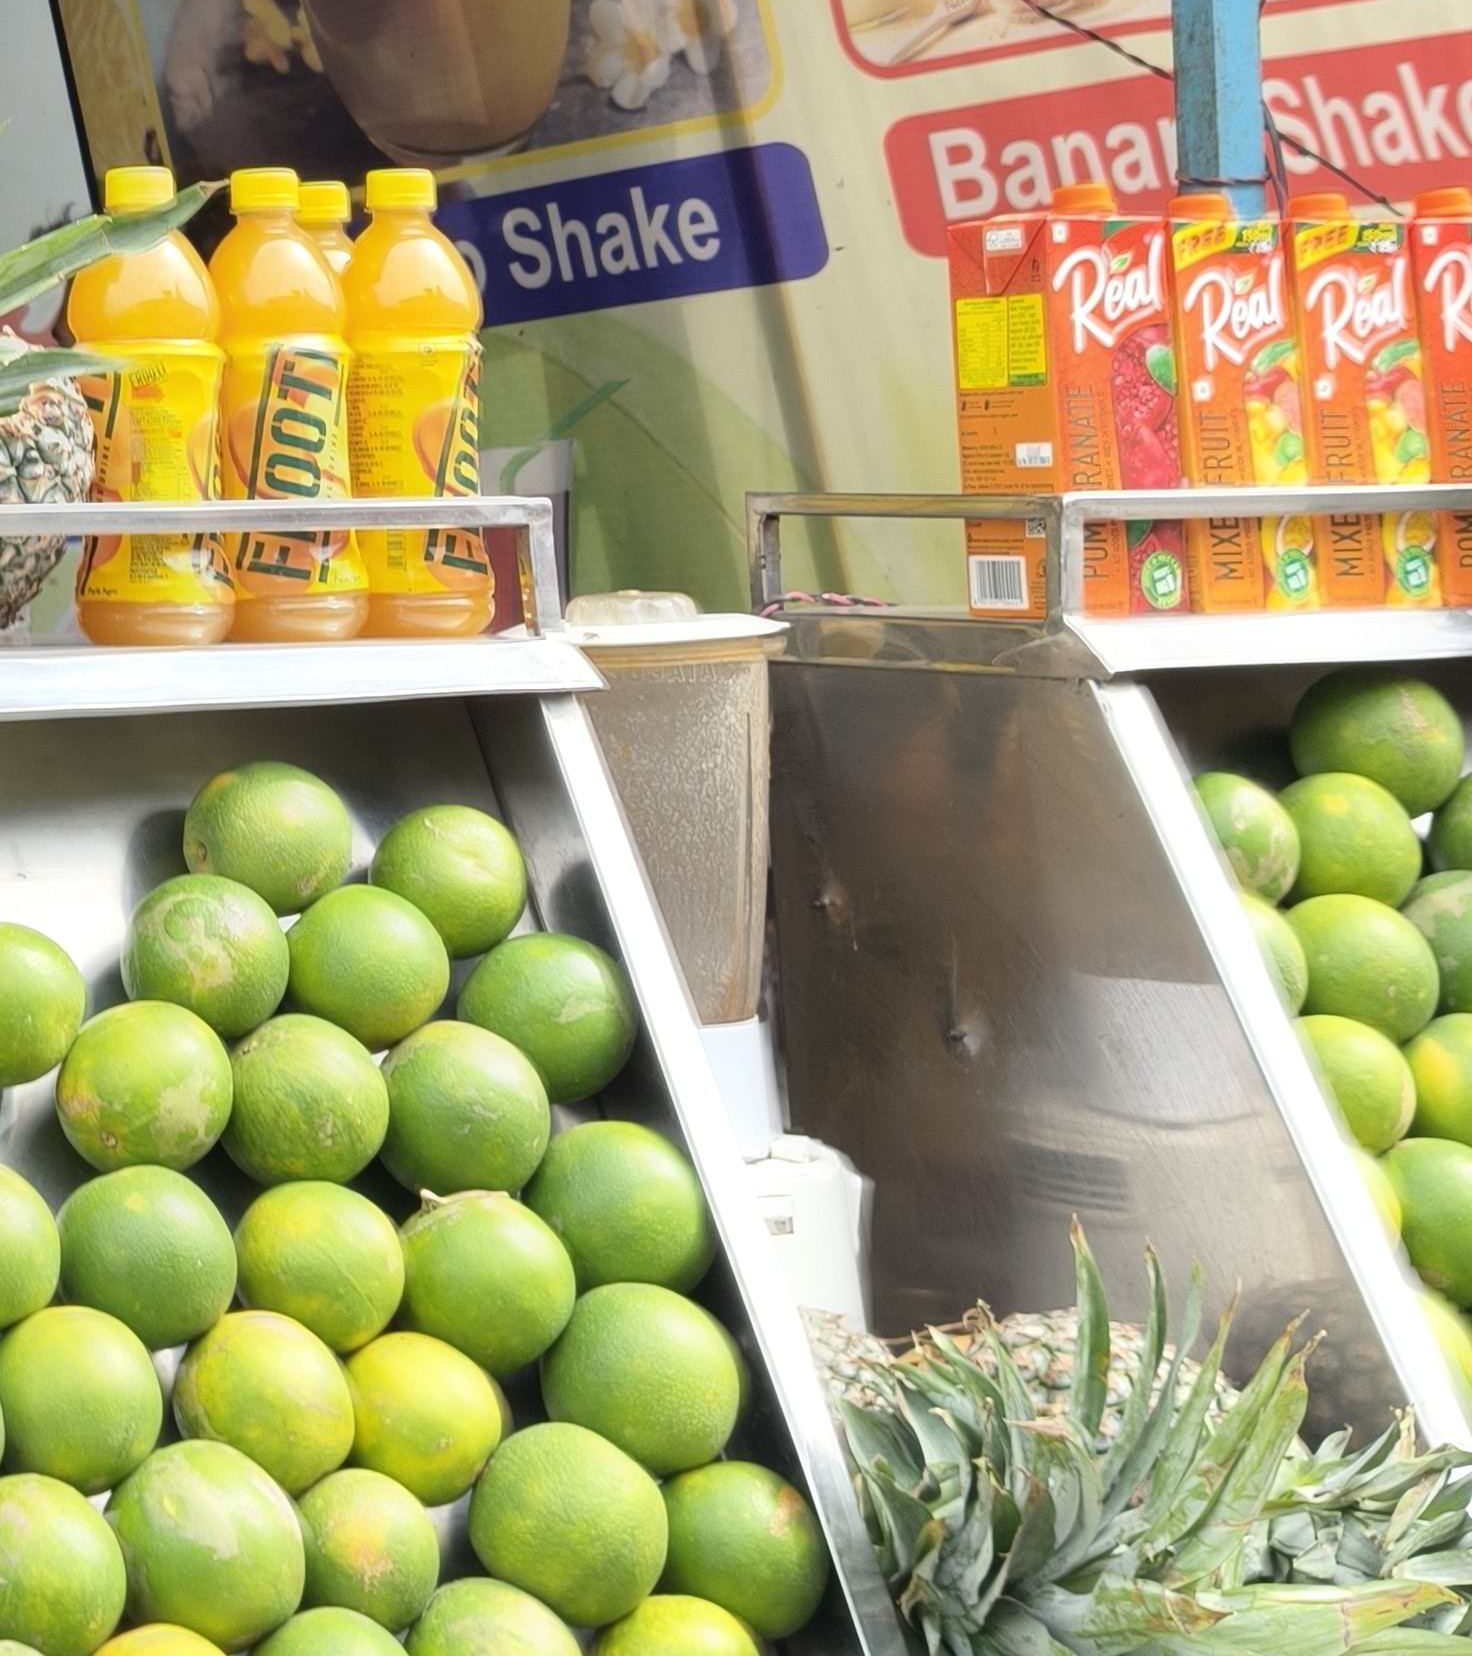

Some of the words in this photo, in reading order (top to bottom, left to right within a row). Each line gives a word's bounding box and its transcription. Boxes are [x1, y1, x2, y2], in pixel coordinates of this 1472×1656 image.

[927, 118, 1177, 220] Bana
[502, 186, 721, 290] Shake
[1198, 411, 1235, 486] FRUIT
[1319, 409, 1355, 483] FRUIT
[1208, 516, 1245, 581] MIXE
[1329, 513, 1365, 577] MIXE
